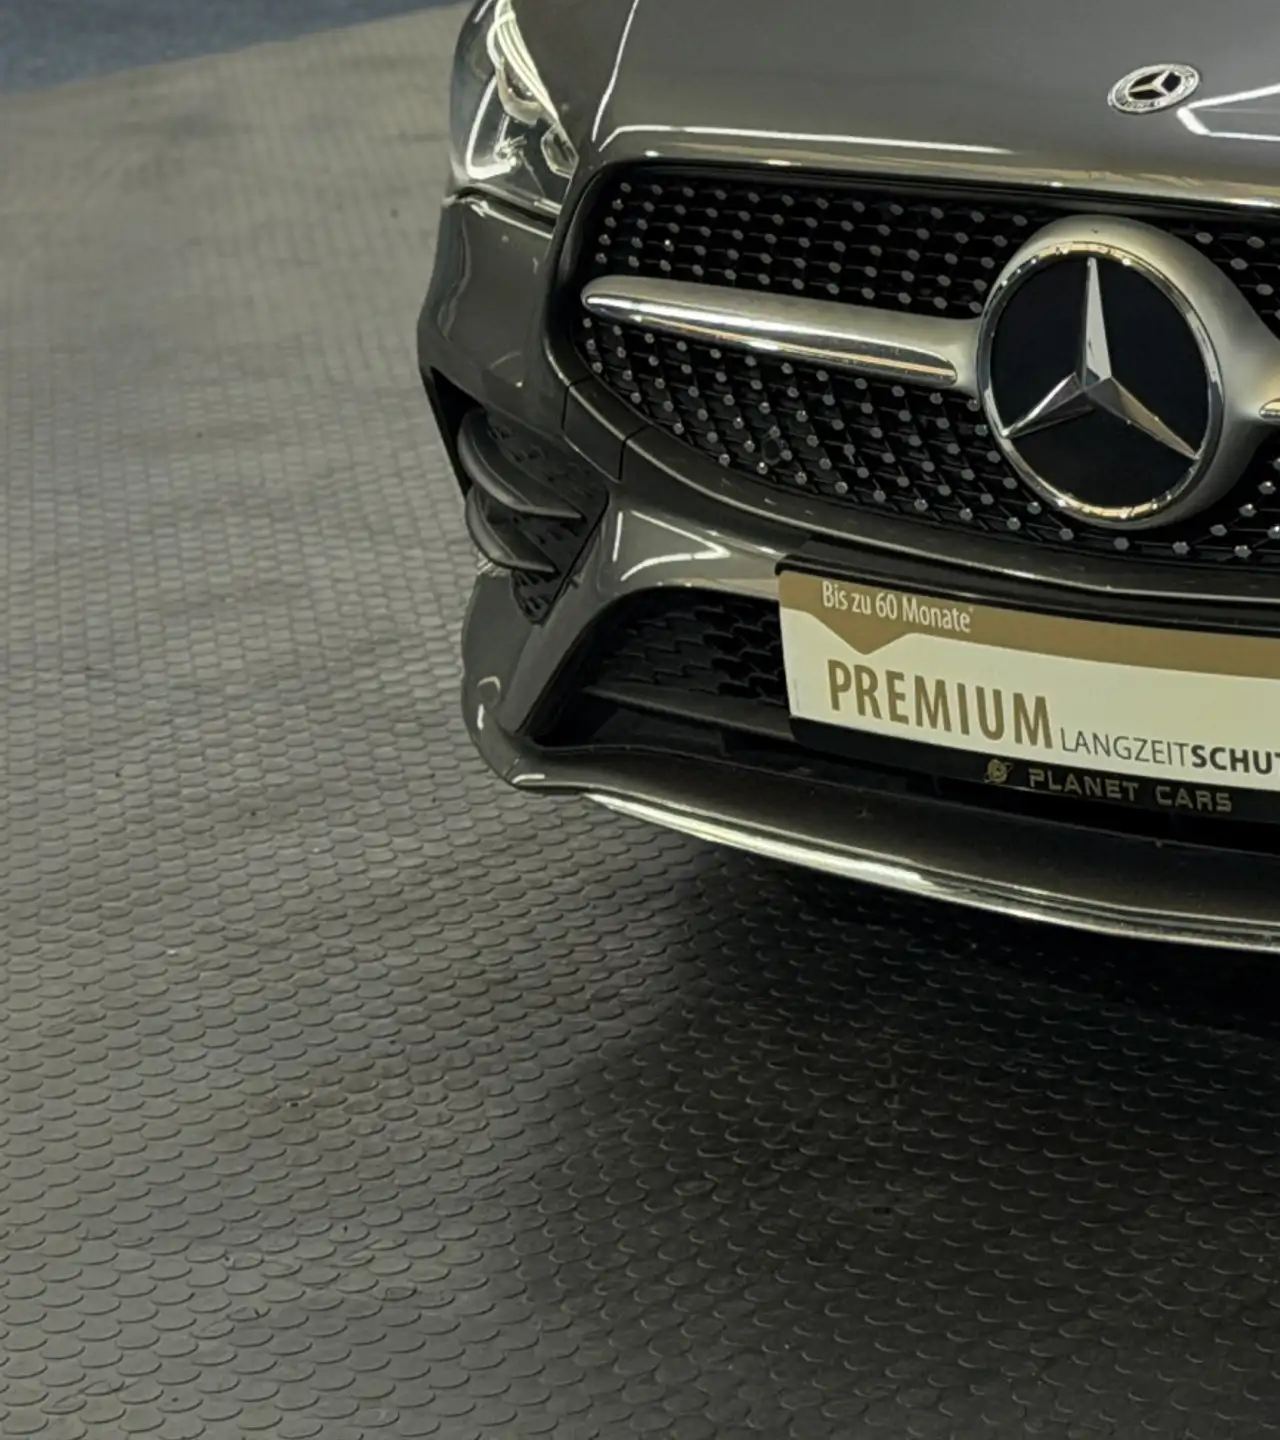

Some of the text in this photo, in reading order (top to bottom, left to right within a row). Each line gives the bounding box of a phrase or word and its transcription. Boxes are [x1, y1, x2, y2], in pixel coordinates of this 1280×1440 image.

[822, 579, 849, 611] Bis
[851, 593, 872, 616] zu
[875, 593, 898, 621] 60
[827, 658, 1053, 750] PREMIUM
[1029, 768, 1233, 812] PLANET CARS
